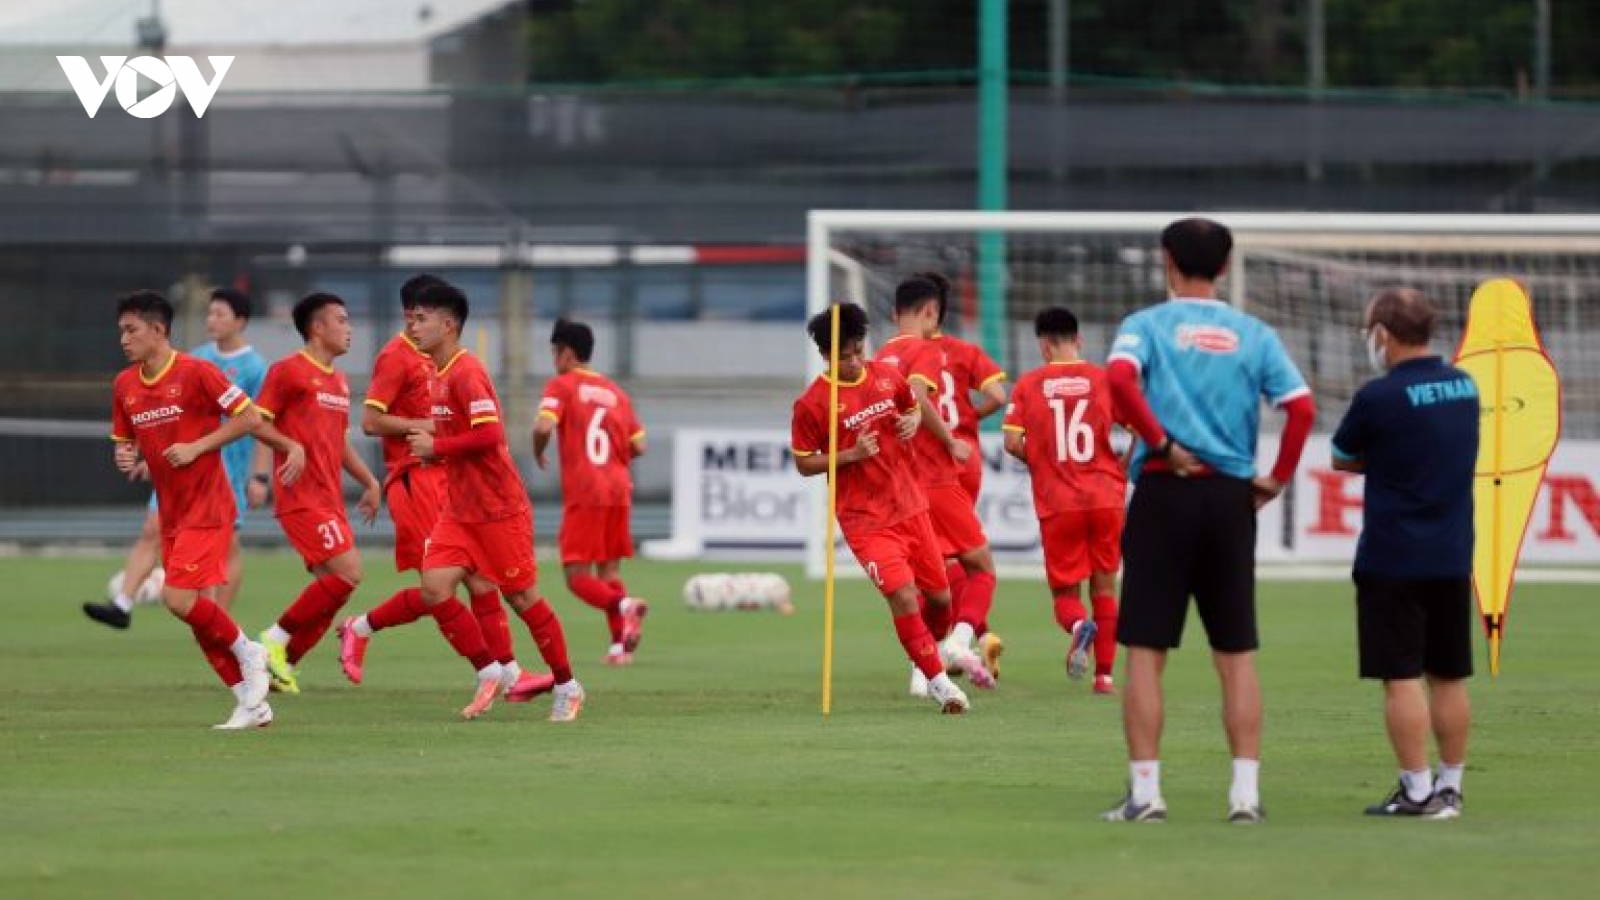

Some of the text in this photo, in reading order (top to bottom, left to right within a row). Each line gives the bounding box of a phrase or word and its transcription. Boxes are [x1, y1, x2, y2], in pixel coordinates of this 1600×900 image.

[131, 404, 183, 425] HONDA
[843, 398, 895, 428] HONDA
[586, 406, 611, 465] 6
[1048, 398, 1095, 463] 16
[318, 519, 344, 549] 31
